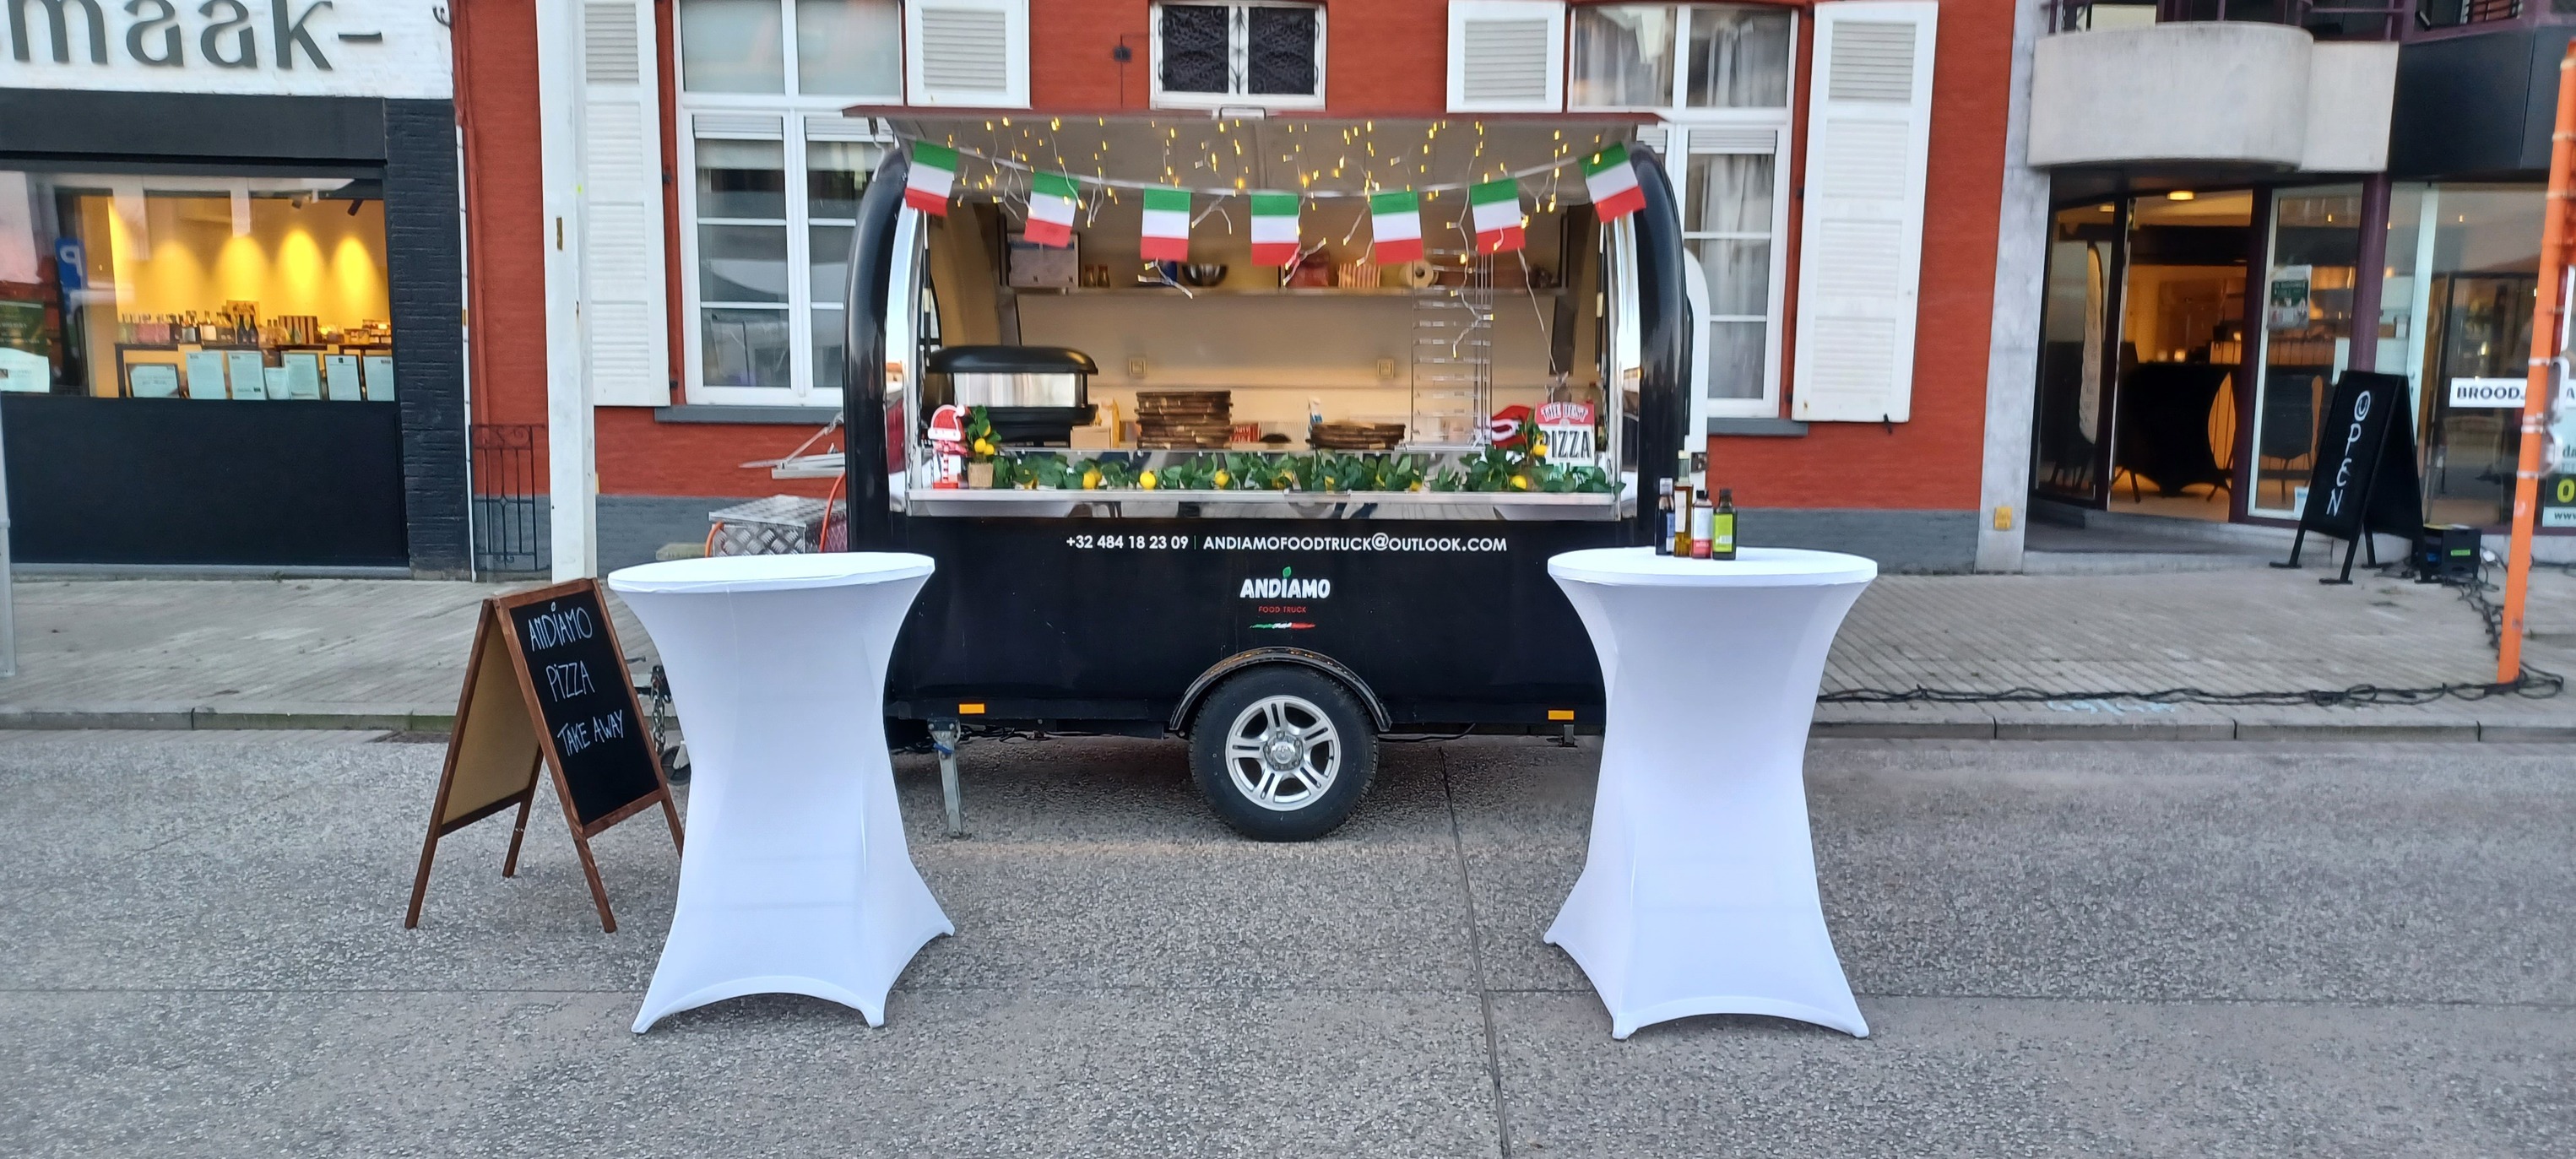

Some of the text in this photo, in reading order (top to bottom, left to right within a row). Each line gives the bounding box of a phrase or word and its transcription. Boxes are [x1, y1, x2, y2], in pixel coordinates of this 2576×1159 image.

[2326, 390, 2371, 517] OPEN
[1066, 533, 1507, 551] +32 484 18 23 09 ANDIAMOFOODTRUCK@OUTLOOK.COM
[1239, 571, 1331, 598] ANDIAMO
[1258, 605, 1307, 614] FOOD TRUCK
[556, 708, 624, 756] TAKE AWAY
